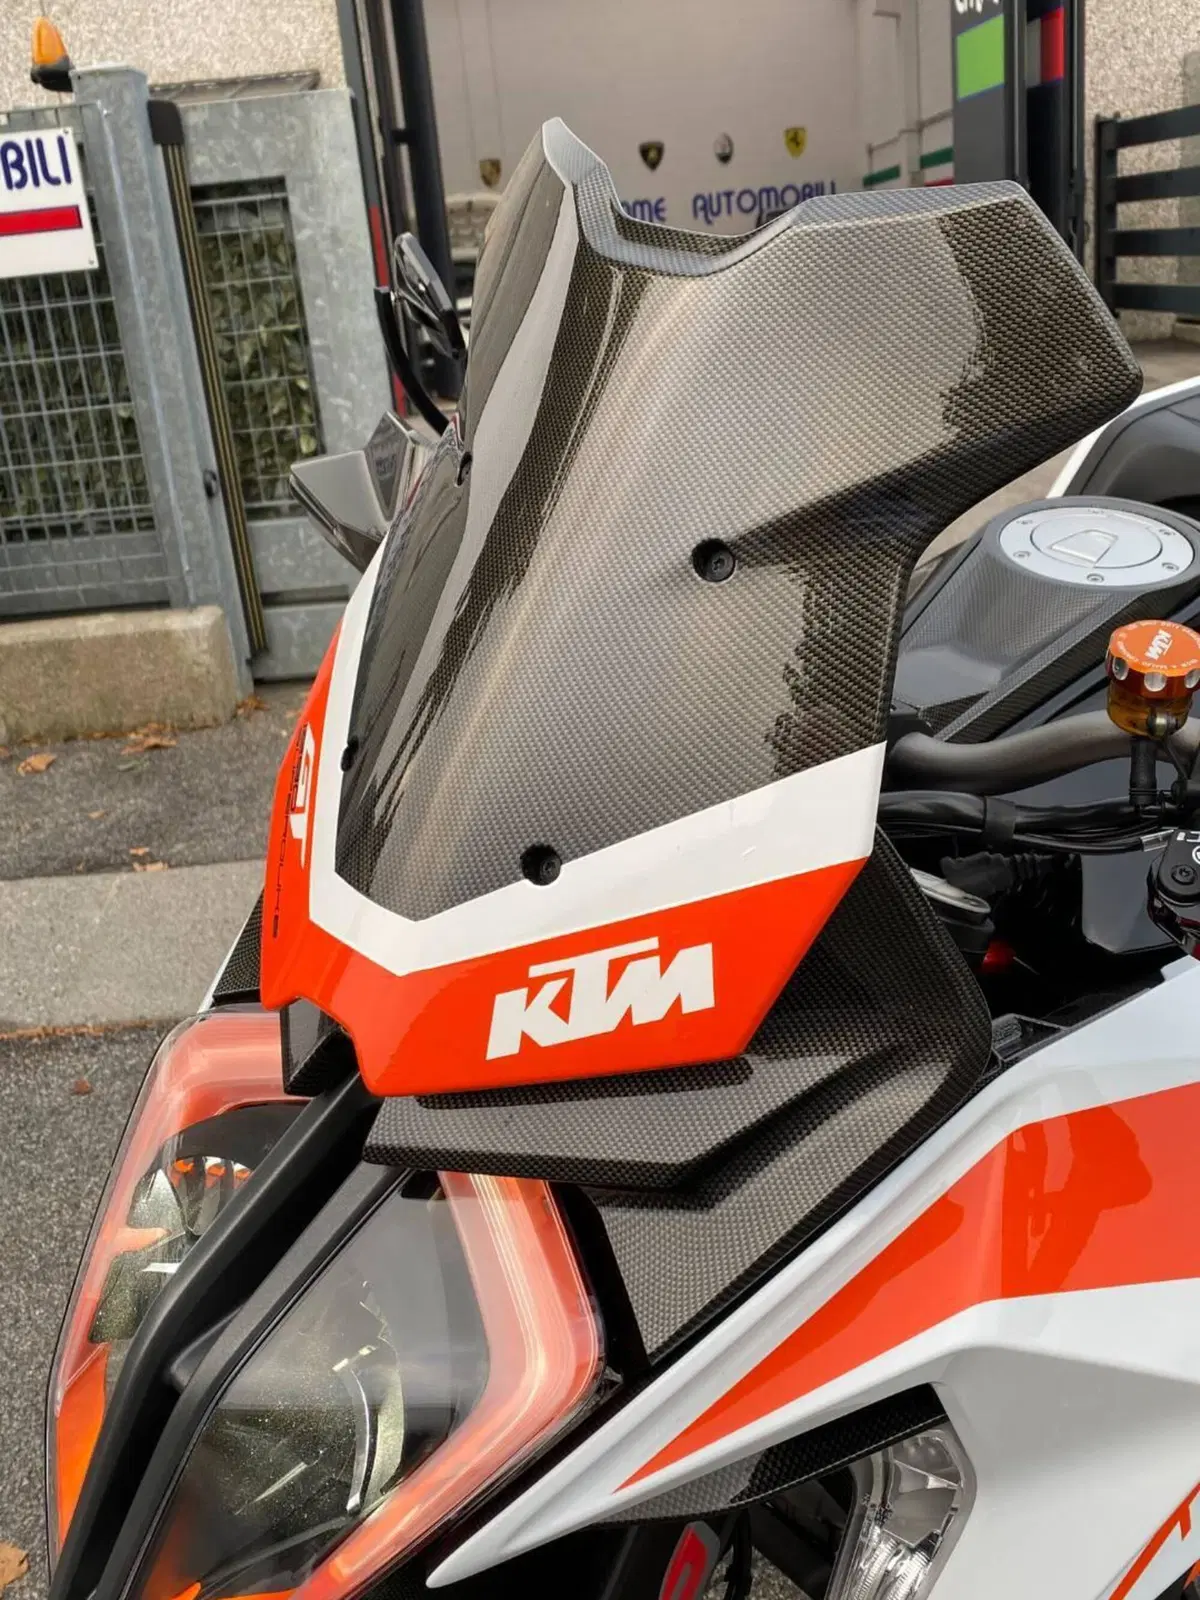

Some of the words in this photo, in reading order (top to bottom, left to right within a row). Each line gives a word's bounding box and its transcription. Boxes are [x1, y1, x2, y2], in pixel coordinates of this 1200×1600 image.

[0, 135, 72, 190] BILI
[1144, 629, 1173, 661] KTM
[485, 936, 715, 1061] KTM
